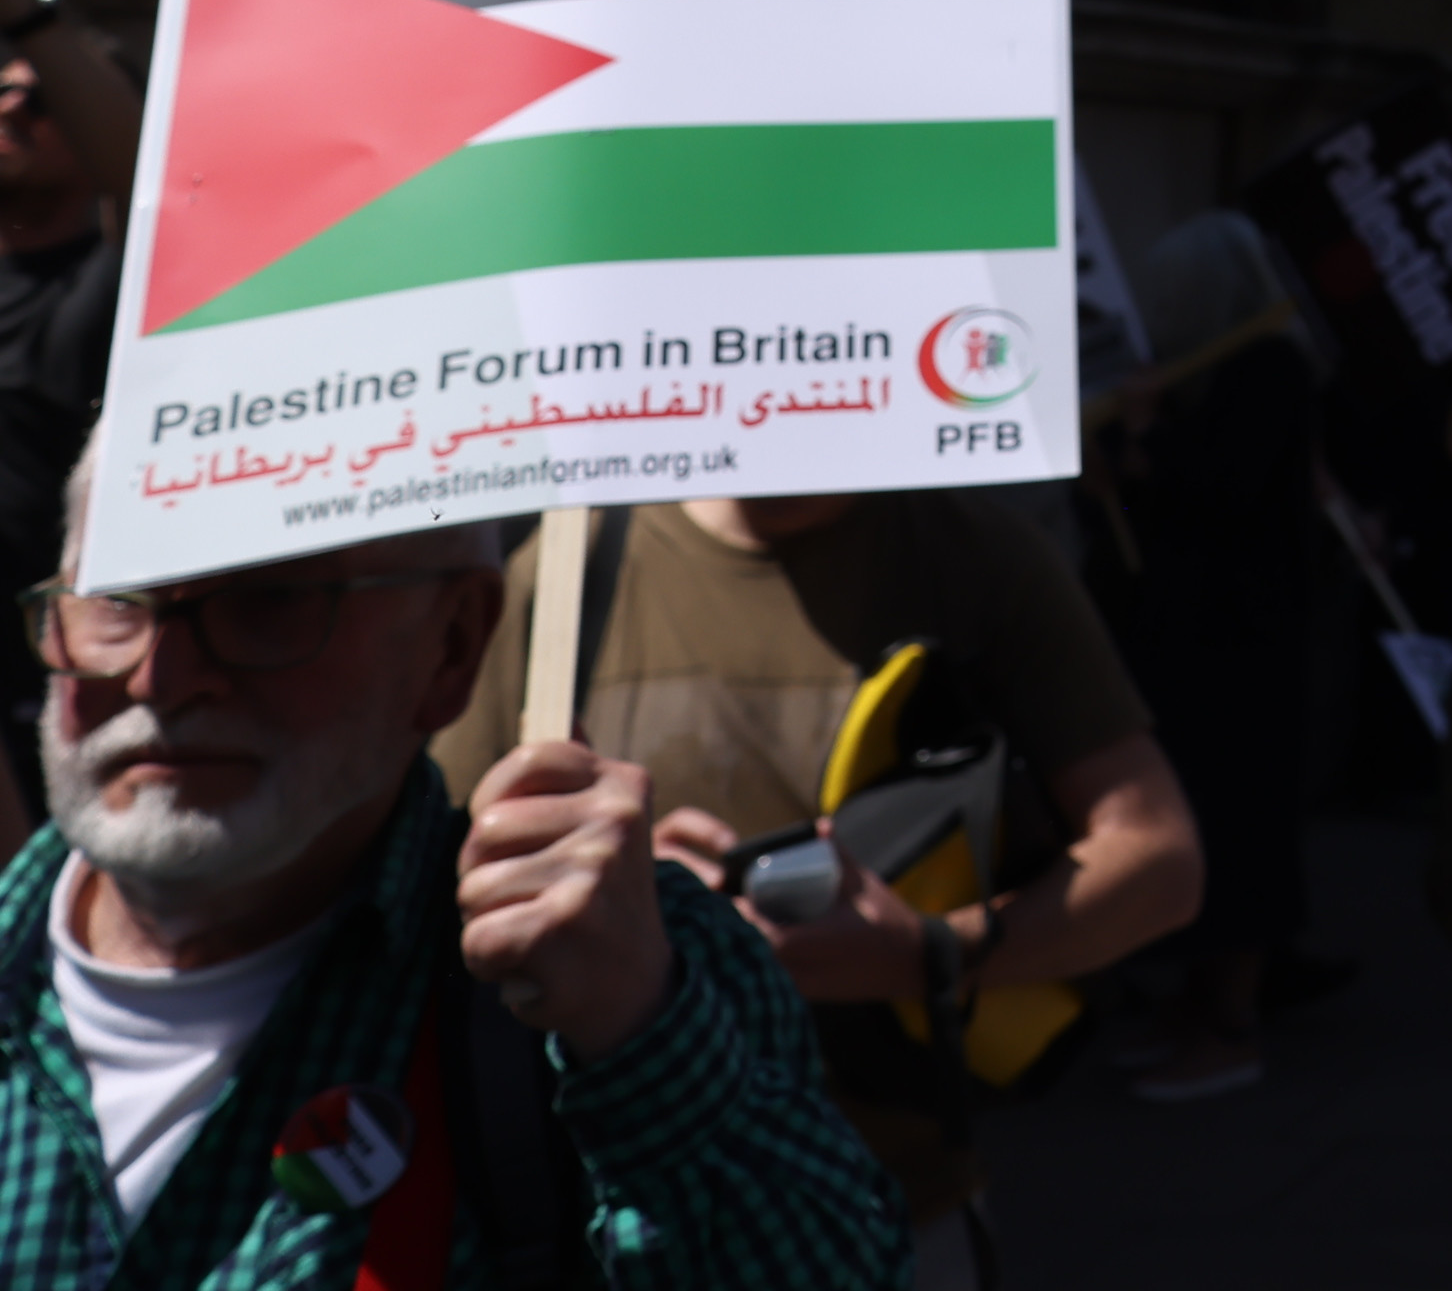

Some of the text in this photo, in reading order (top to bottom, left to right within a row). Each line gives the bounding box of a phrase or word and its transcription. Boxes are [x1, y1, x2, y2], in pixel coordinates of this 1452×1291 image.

[152, 323, 892, 445] Palestine Forum in Britain
[137, 376, 893, 508] المنتدى الفلسطيني في بريطانيا
[283, 446, 740, 529] www.palestinianforum.org.uk
[936, 422, 1024, 456] PFB
